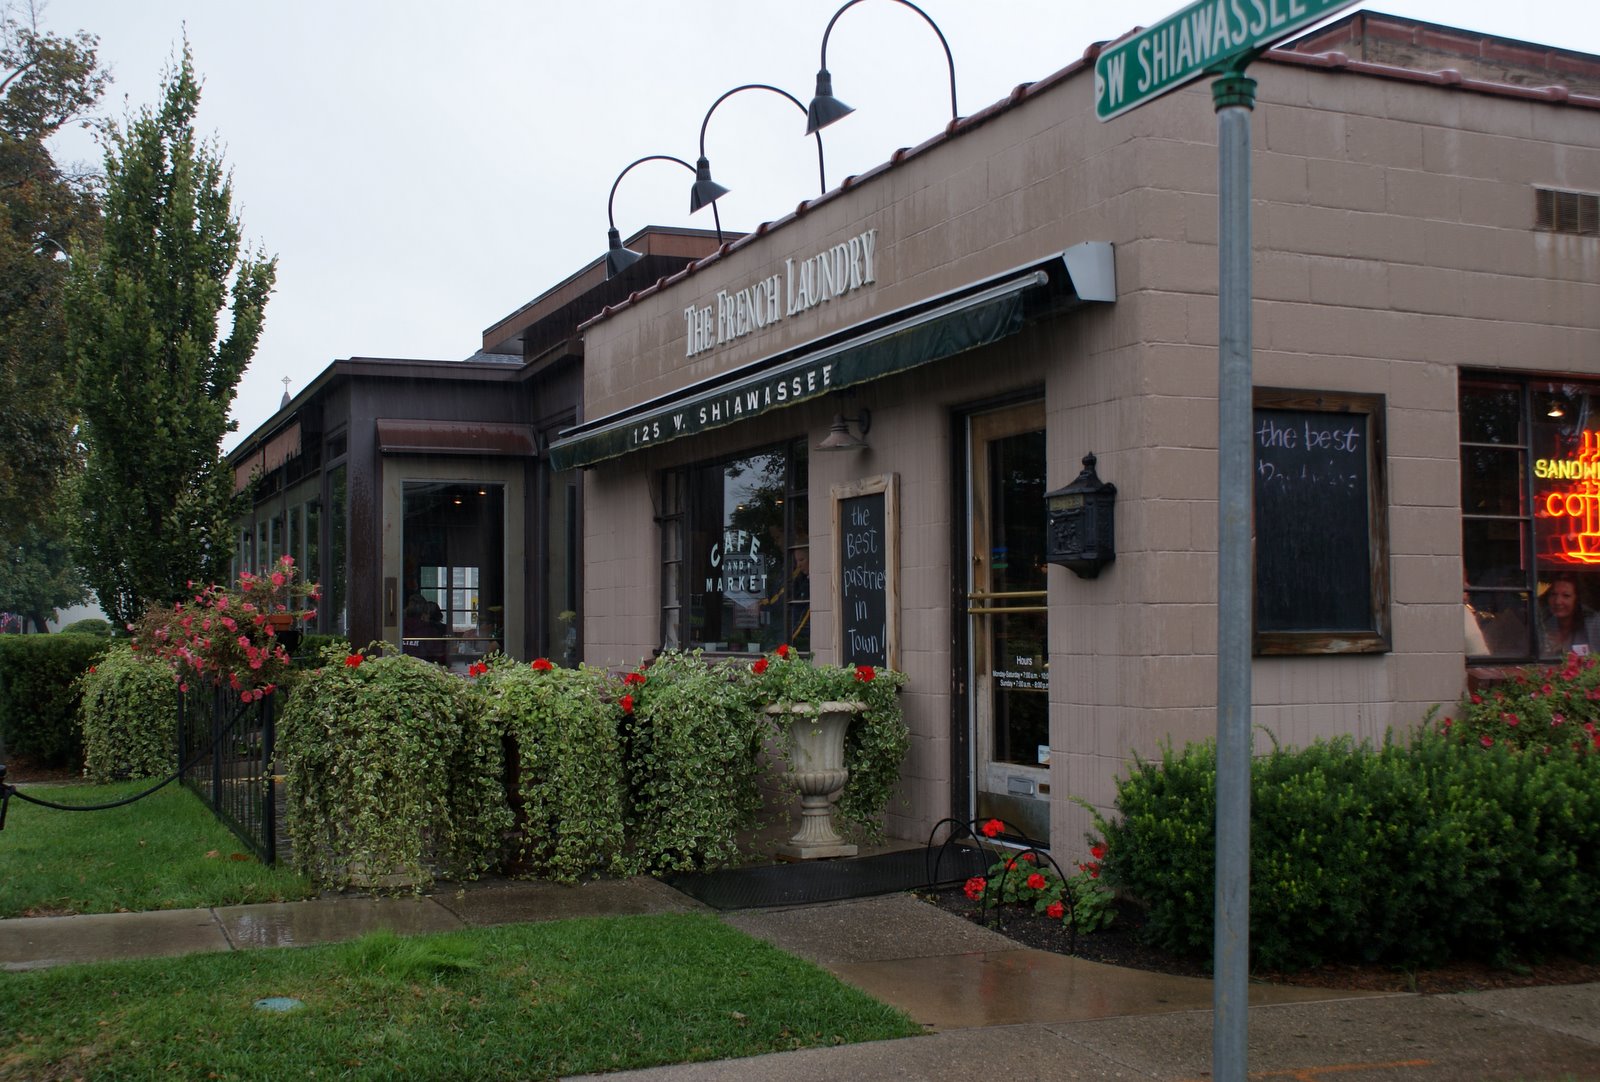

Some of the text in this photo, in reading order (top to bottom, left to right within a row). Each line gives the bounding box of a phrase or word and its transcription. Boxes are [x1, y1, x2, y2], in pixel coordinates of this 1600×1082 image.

[1106, 51, 1125, 107] W
[684, 228, 878, 357] THE FRENCH LAUNDRY
[634, 365, 832, 444] 125 W. SHIAWASSEE
[1256, 420, 1360, 452] the best
[851, 506, 870, 526] the
[710, 529, 760, 567] CAFE
[727, 561, 744, 571] AND
[705, 574, 768, 592] MARKET
[855, 595, 868, 621] in
[1016, 655, 1033, 666] Hours
[1000, 679, 1013, 688] Sunday
